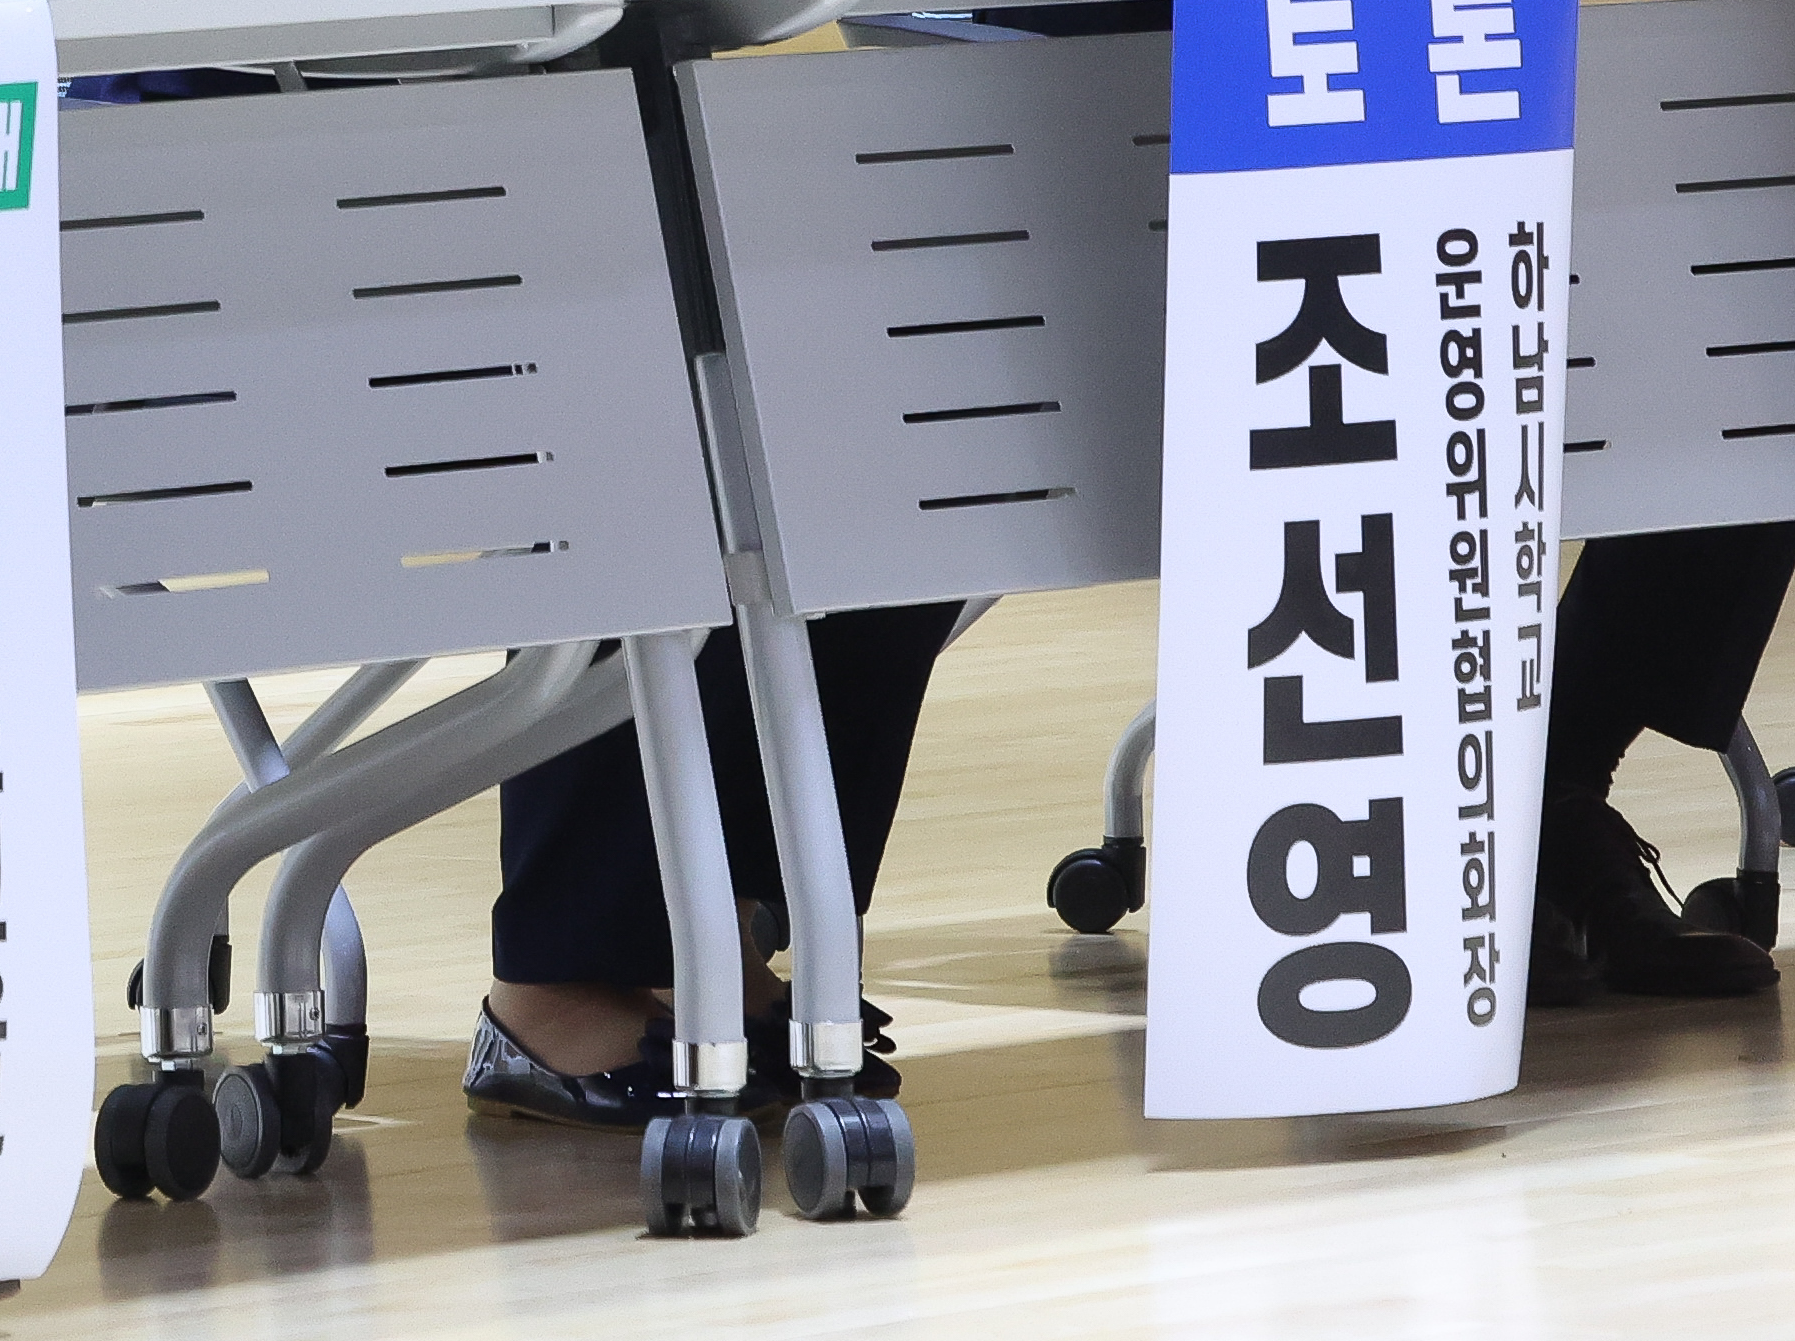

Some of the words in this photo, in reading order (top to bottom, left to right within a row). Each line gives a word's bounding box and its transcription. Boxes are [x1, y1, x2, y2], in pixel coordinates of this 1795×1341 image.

[1246, 233, 1413, 1050] 조선영
[1435, 227, 1500, 1028] 운영위원협의회장
[1507, 220, 1549, 712] 하남시학교
